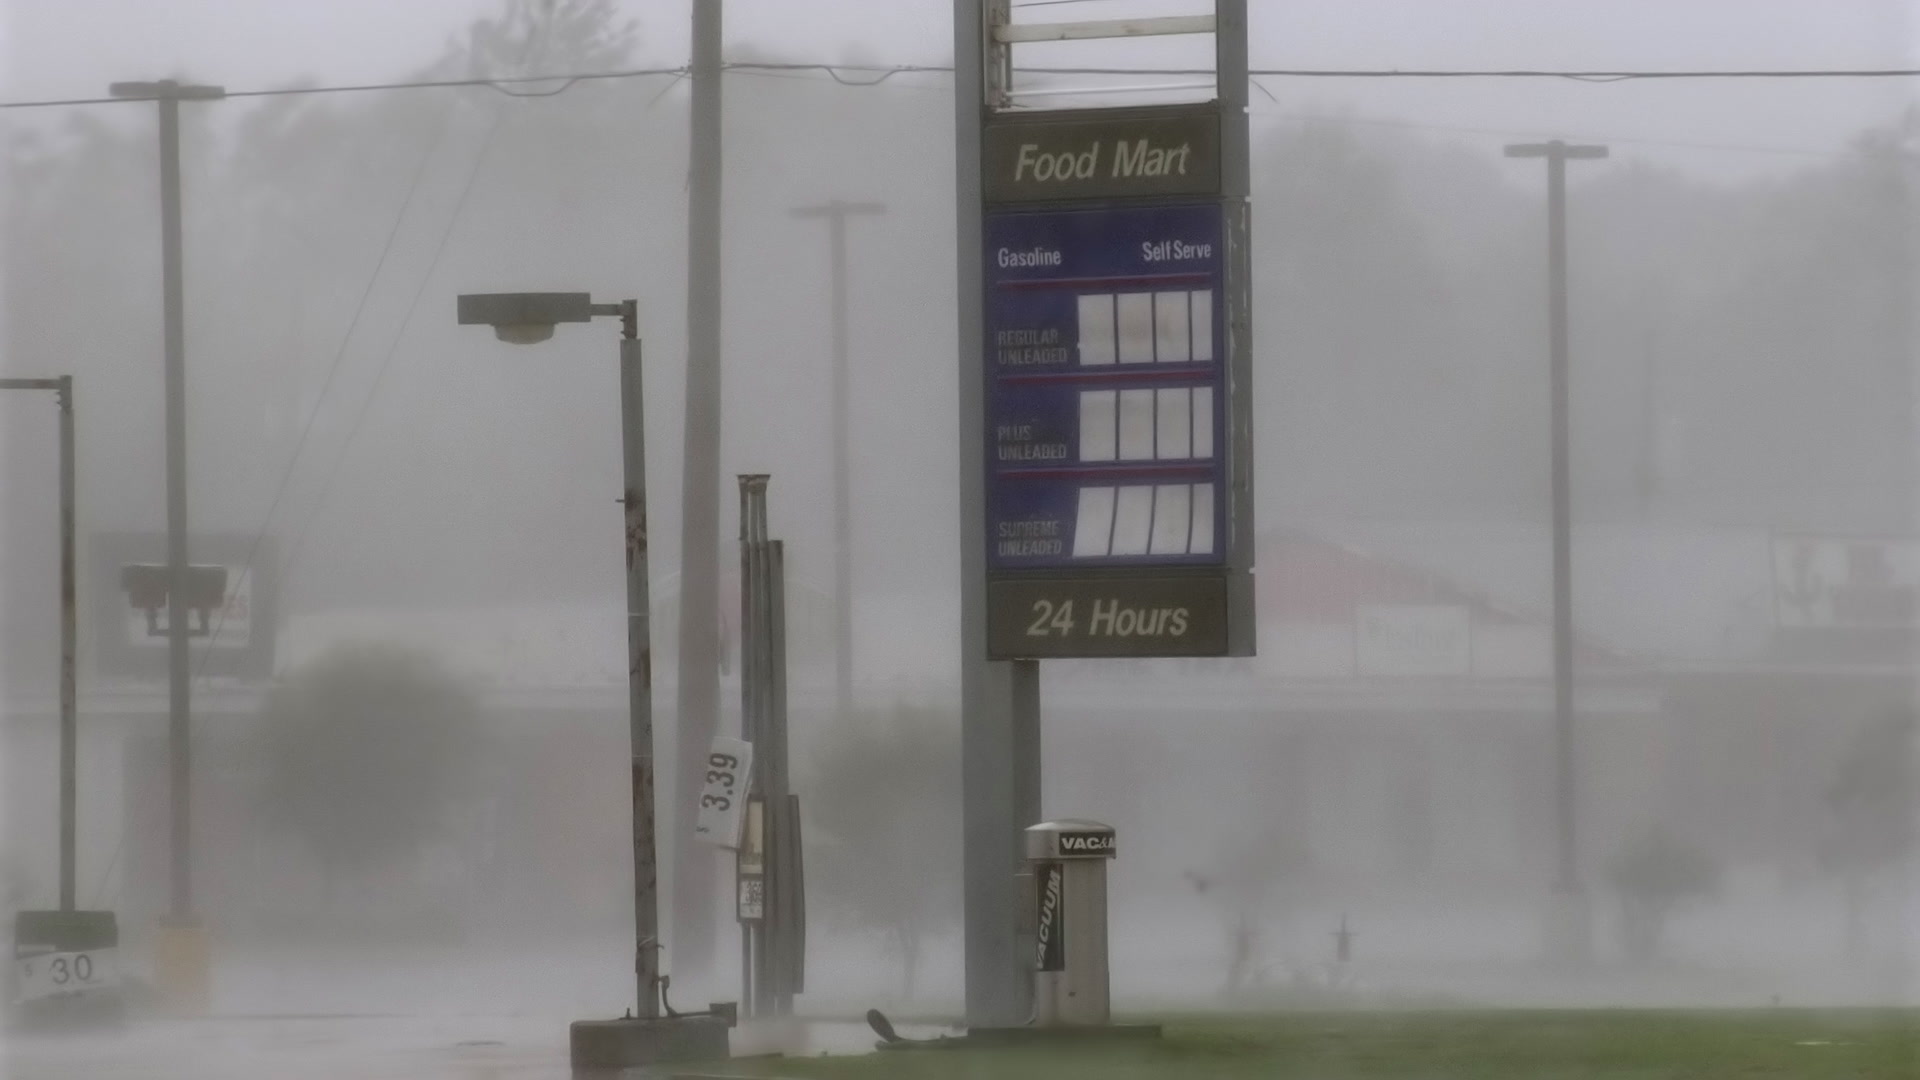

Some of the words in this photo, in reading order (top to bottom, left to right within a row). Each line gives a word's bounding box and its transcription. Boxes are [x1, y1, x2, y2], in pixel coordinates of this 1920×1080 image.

[1014, 141, 1099, 182] Food
[1112, 139, 1191, 178] Mart
[998, 248, 1063, 268] Gasoline
[1142, 242, 1172, 262] Self
[1173, 240, 1212, 260] Serve
[998, 327, 1059, 346] REGULAR
[998, 347, 1068, 365] UNLEADED
[998, 425, 1031, 441] PLUS
[998, 444, 1067, 460] UNLEADED
[998, 520, 1060, 538] SUPREME
[998, 539, 1063, 556] UNLEADED
[1026, 599, 1074, 636] 24
[1089, 598, 1190, 637] Hours
[701, 752, 738, 812] 3.39
[1036, 869, 1061, 970] VACUUM
